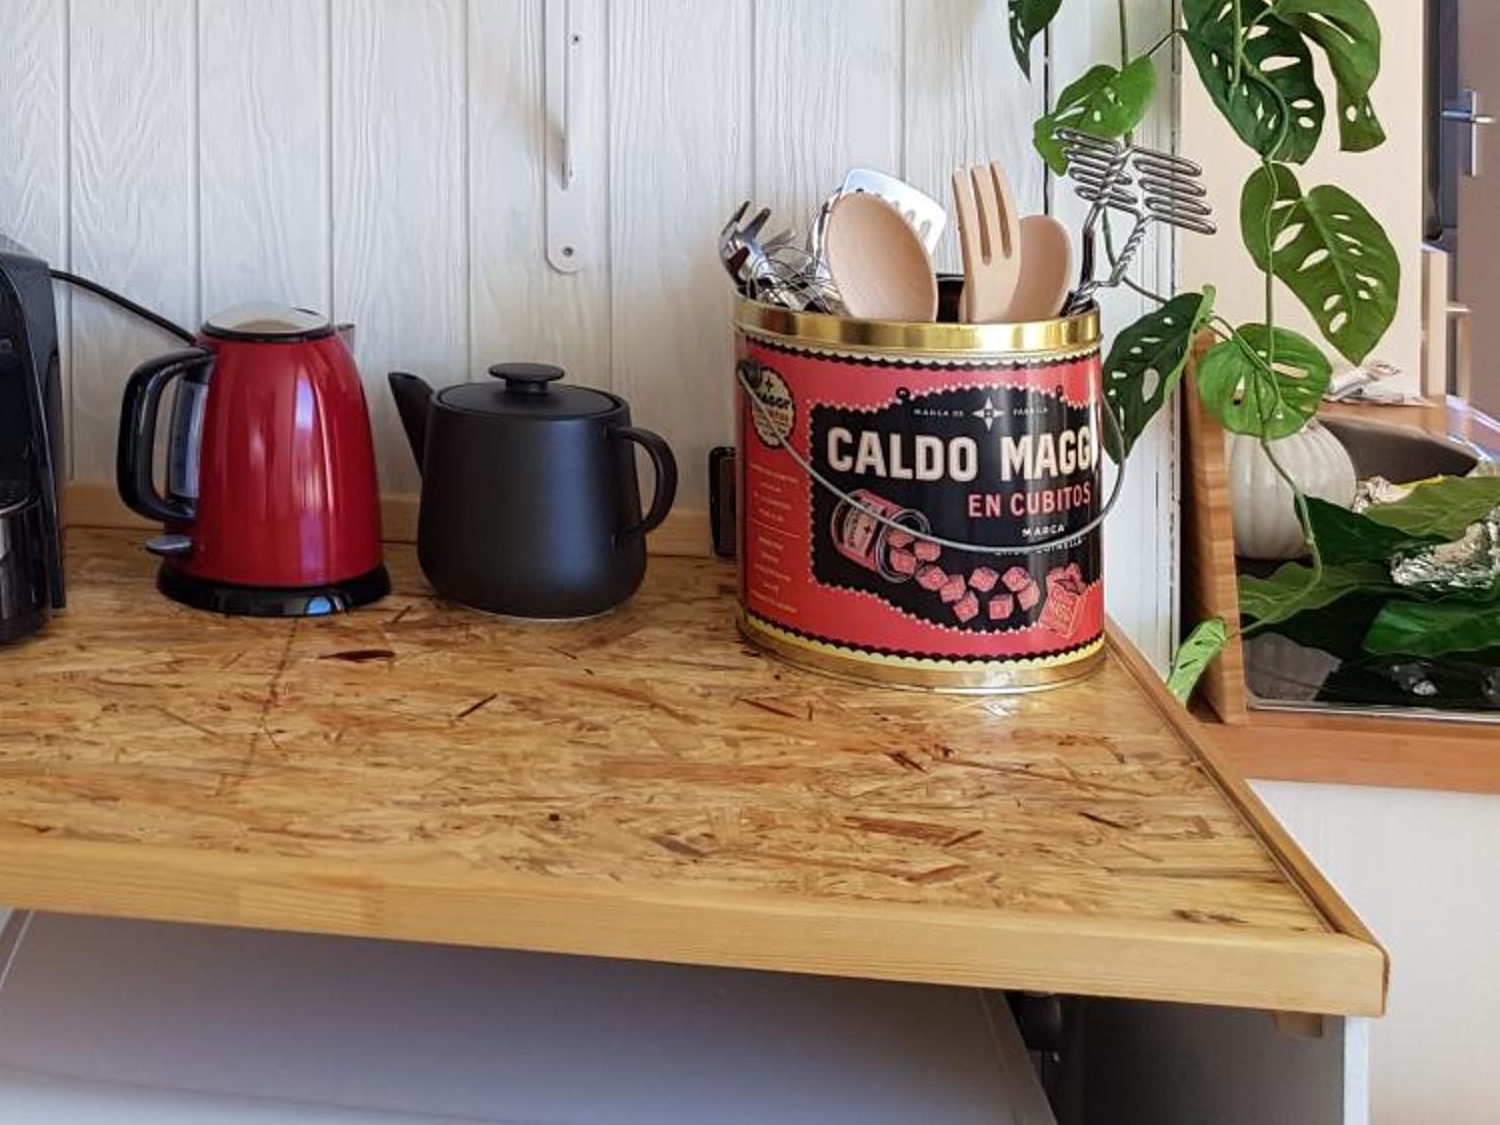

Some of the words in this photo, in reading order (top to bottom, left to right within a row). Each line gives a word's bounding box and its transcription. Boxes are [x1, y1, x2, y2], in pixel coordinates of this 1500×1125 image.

[827, 426, 978, 482] CALDO
[968, 494, 1001, 518] EN
[1010, 481, 1091, 516] CUBITOS
[1022, 524, 1065, 537] MARCA
